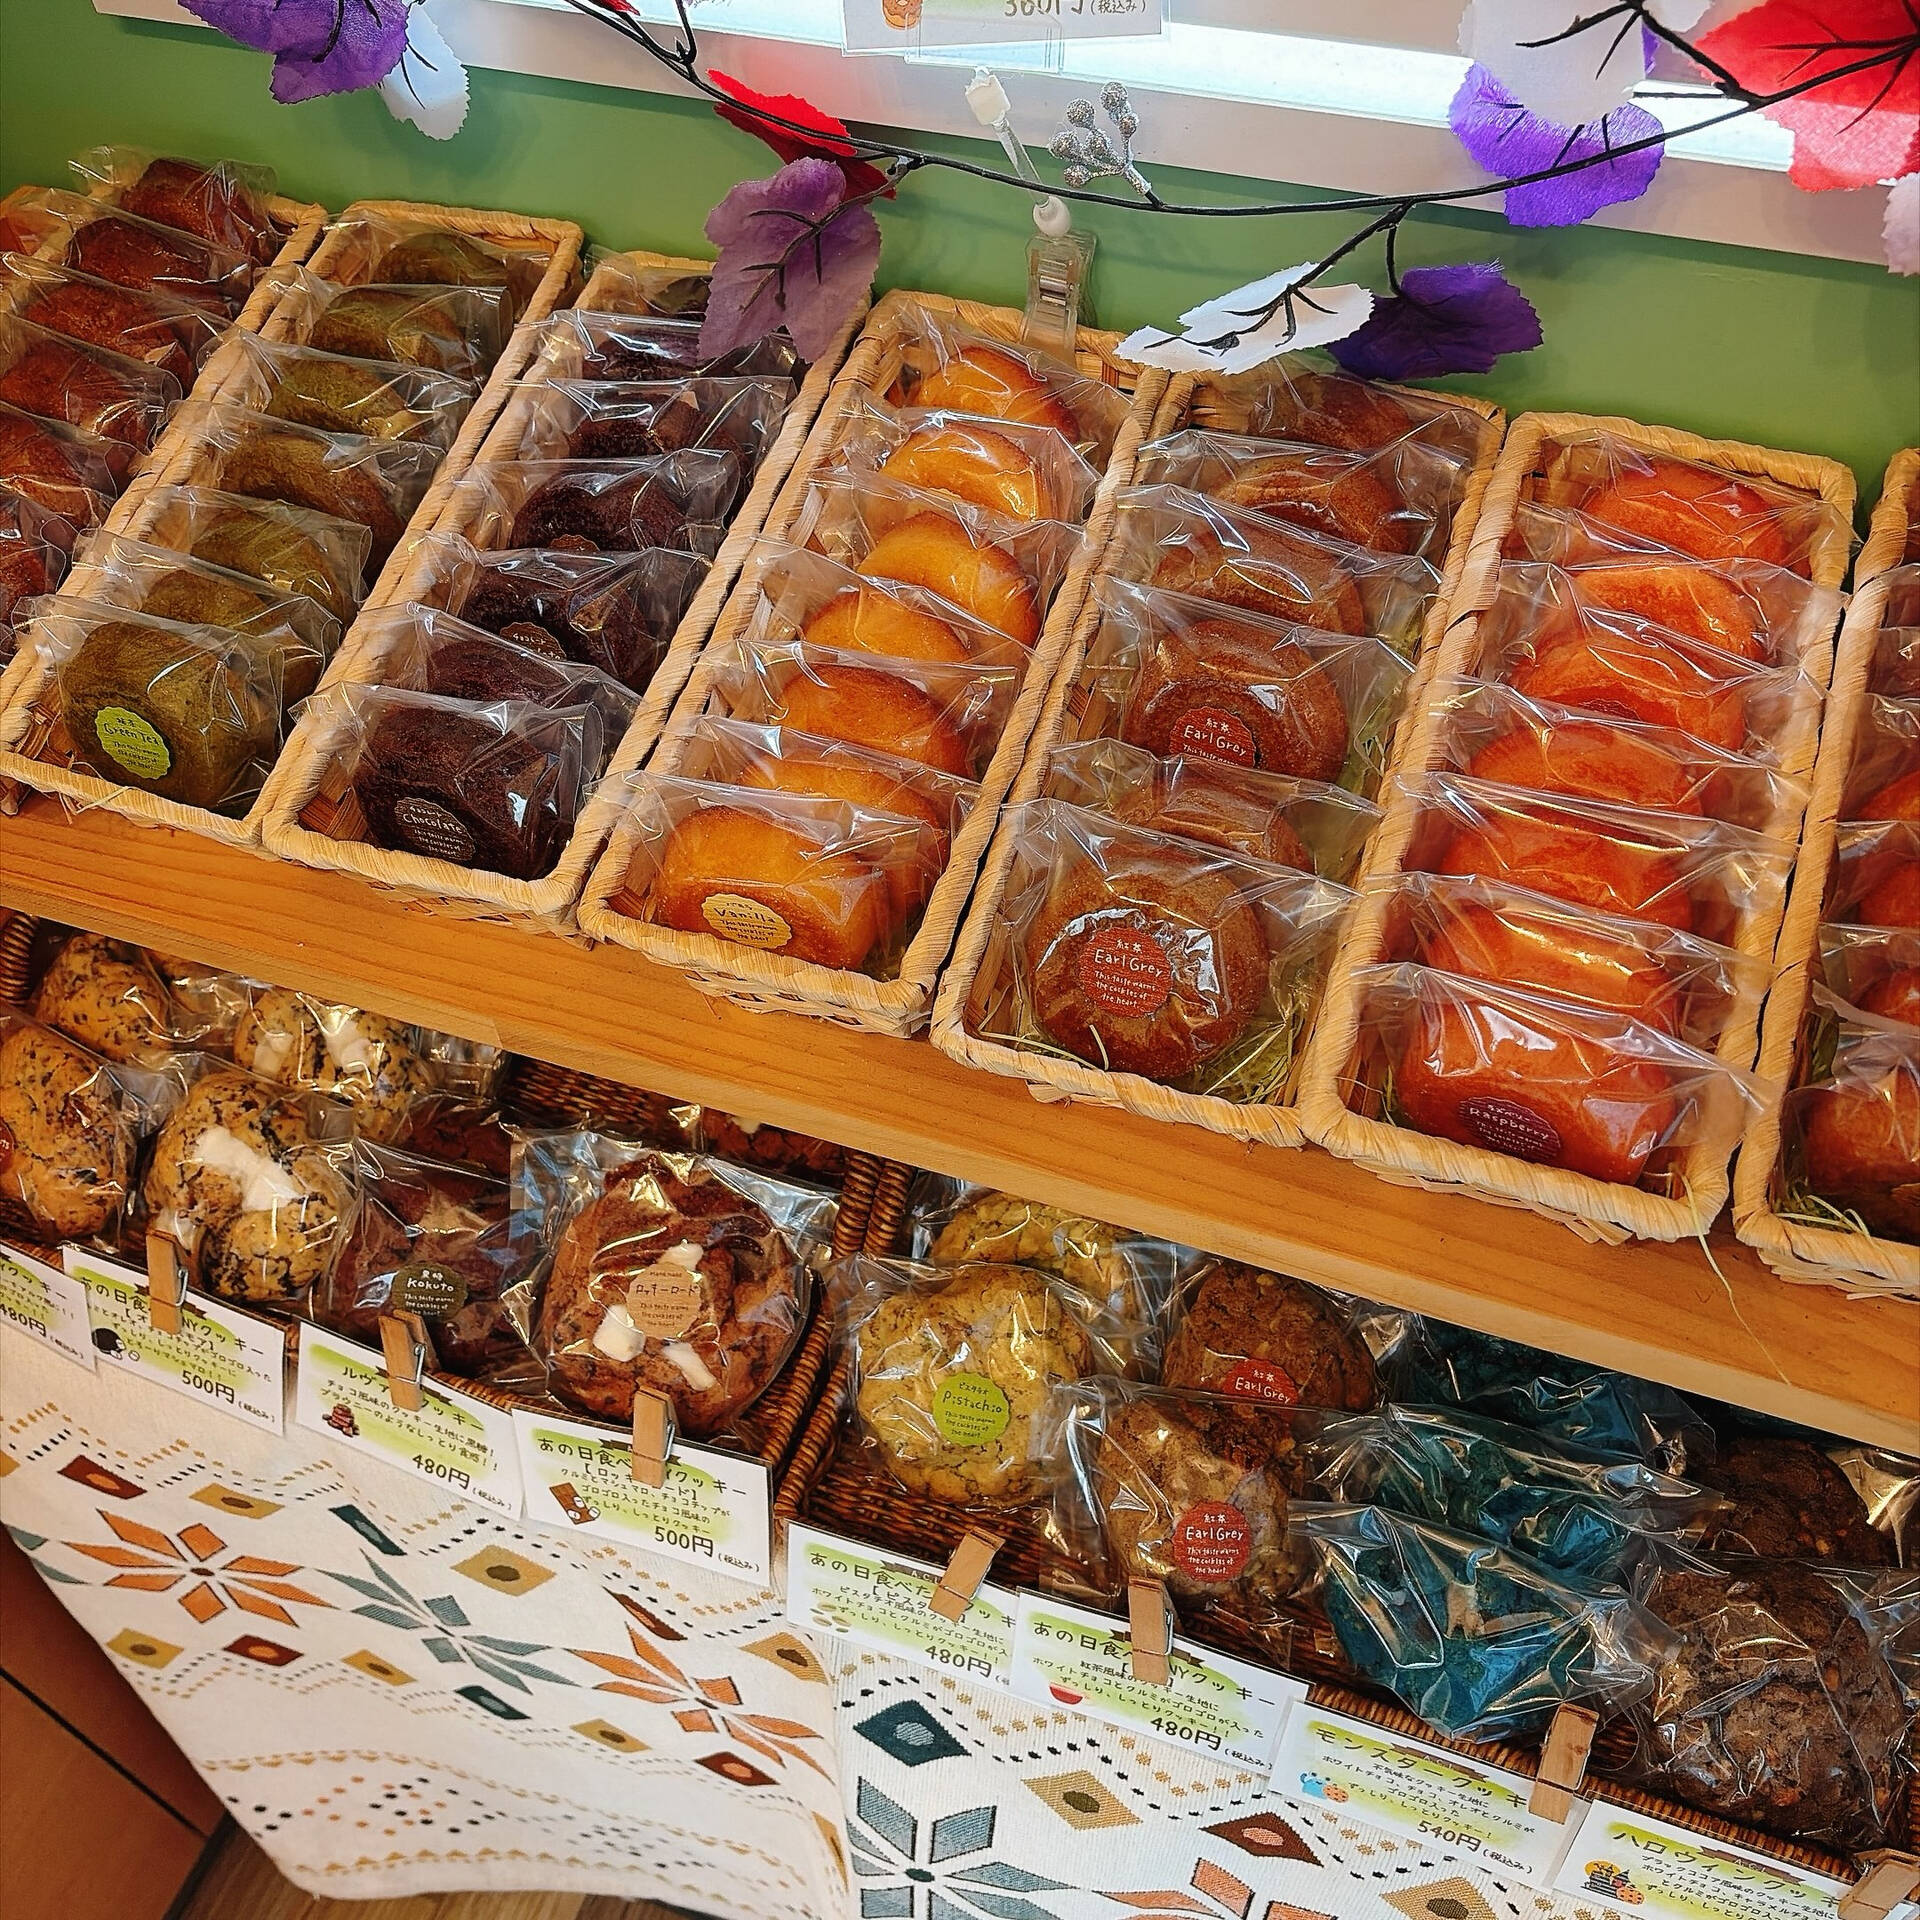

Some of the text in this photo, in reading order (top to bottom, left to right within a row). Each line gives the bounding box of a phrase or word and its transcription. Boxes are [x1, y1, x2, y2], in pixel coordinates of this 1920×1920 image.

[103, 722, 160, 746] Green Tea
[1183, 724, 1247, 756] Earl Grey
[402, 813, 464, 834] Chocolate
[713, 907, 776, 923] Vanilla
[1094, 949, 1163, 977] Earl Grey
[1095, 970, 1156, 991] This taste warms
[1469, 1107, 1549, 1140] Raspberry
[407, 1277, 455, 1292] Kokuto
[636, 1284, 699, 1296] ロッキーロード
[182, 1370, 235, 1404] 500円
[1235, 1376, 1291, 1404] Earl Grey
[412, 1454, 470, 1490] 480円
[654, 1525, 713, 1558] 500円
[1185, 1526, 1244, 1541] Earl Grey
[925, 1645, 992, 1678] 480円
[1033, 1621, 1276, 1706] あの日食NYクッキー
[1151, 1717, 1222, 1751] 480円
[1417, 1821, 1482, 1853] 540円
